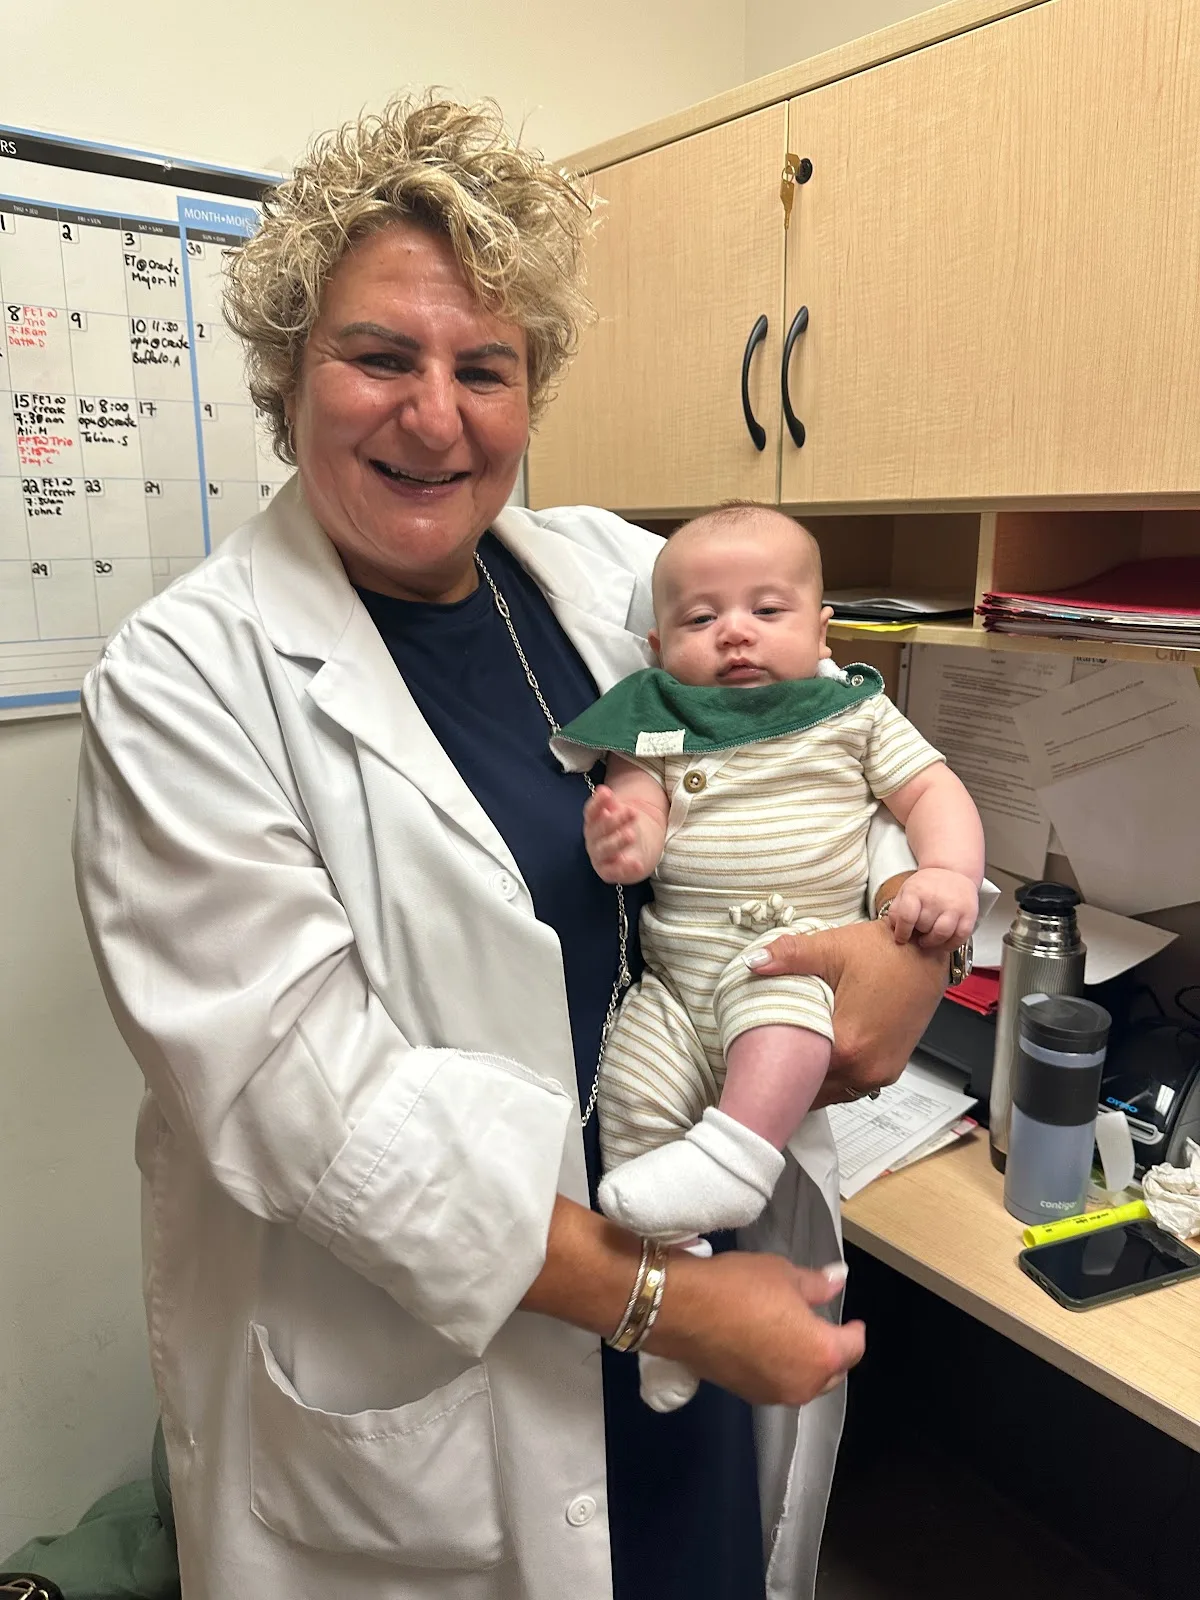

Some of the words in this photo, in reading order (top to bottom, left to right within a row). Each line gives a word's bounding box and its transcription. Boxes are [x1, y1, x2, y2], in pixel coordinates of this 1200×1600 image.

[0, 140, 17, 155] RS
[62, 224, 73, 241] 2
[124, 232, 135, 246] 3
[186, 241, 202, 256] 30
[7, 305, 21, 322] 8
[70, 312, 82, 329] 9
[131, 318, 147, 335] 10
[152, 320, 179, 333] 11:30
[196, 323, 206, 338] 2
[14, 393, 30, 409] 15
[79, 398, 95, 415] 16
[99, 398, 129, 414] 8:00
[139, 401, 157, 417] 17
[204, 404, 213, 418] 9
[22, 479, 40, 494] 22
[84, 479, 102, 493] 23
[144, 481, 161, 495] 24
[31, 562, 48, 576] 29
[95, 560, 113, 574] 30
[1040, 1199, 1074, 1211] contigo
